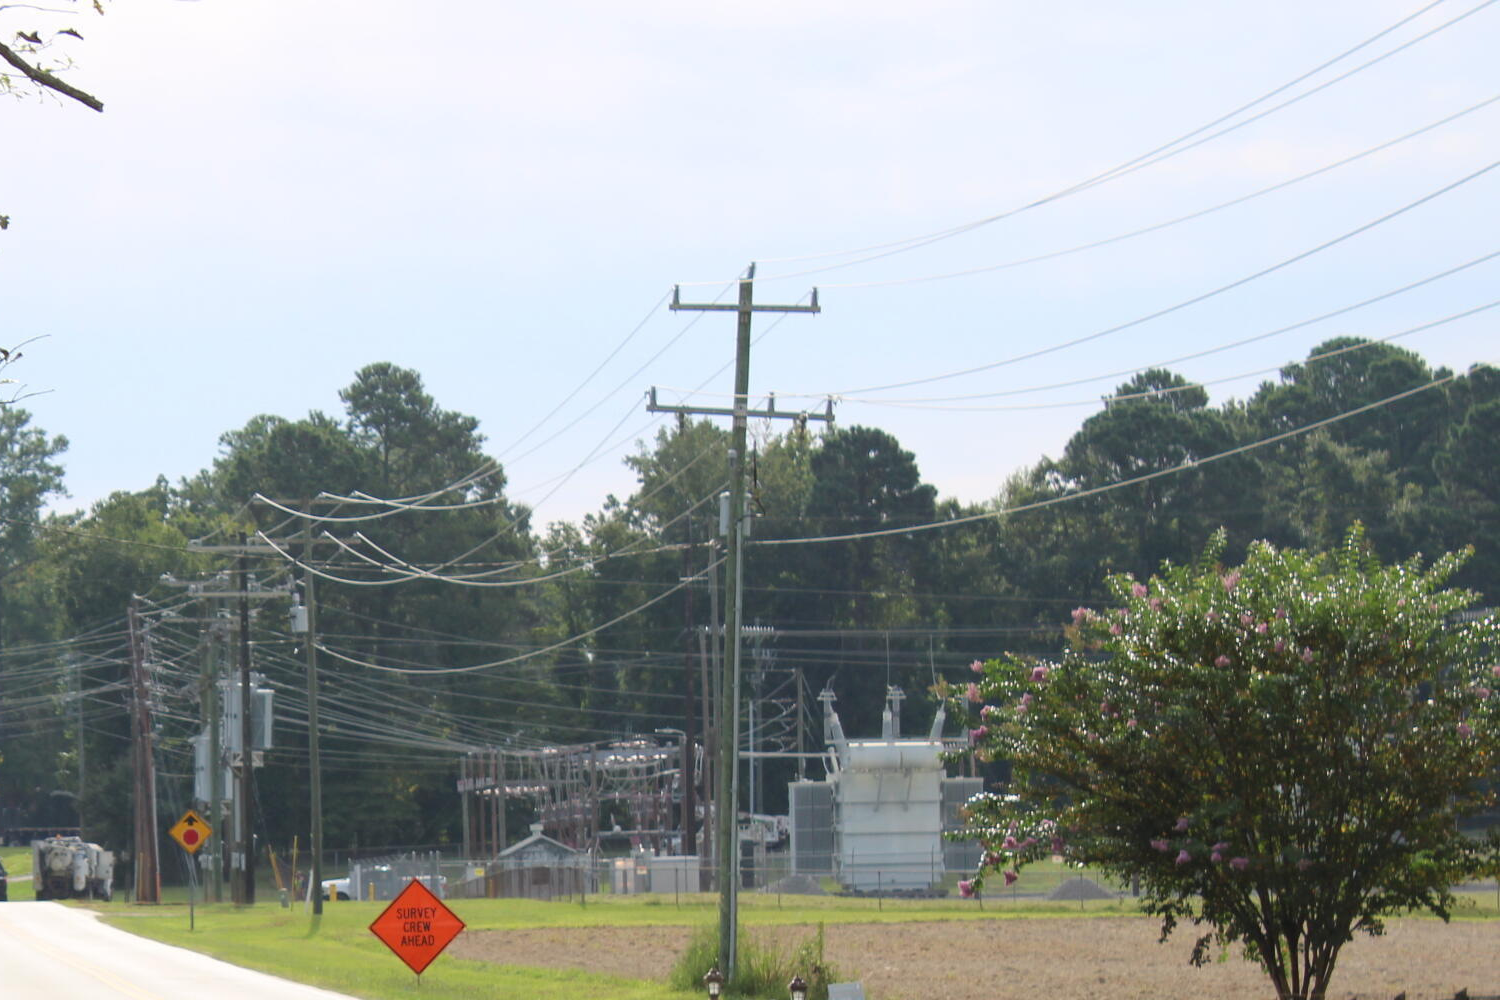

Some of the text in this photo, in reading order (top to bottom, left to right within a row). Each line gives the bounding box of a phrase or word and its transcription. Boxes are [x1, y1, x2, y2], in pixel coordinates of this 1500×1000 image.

[396, 908, 437, 920] SURVEY
[403, 921, 431, 933] CREW
[400, 935, 435, 947] AHEAD
